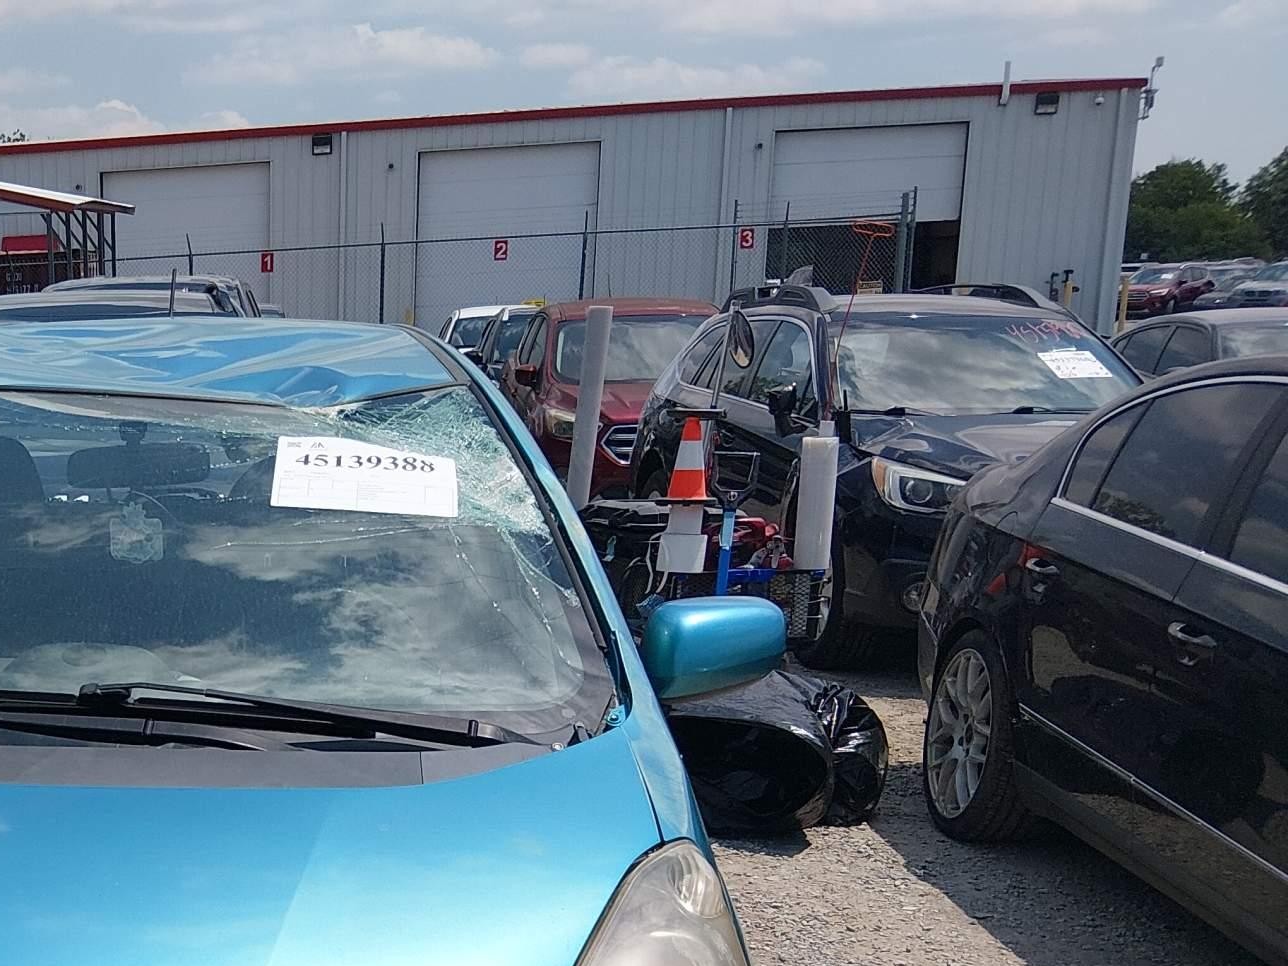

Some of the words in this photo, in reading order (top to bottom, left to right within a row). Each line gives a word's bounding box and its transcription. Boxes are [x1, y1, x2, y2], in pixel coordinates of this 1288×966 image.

[741, 230, 753, 247] 3
[495, 242, 507, 259] 2
[263, 254, 272, 271] 1
[295, 453, 435, 473] 45139388
